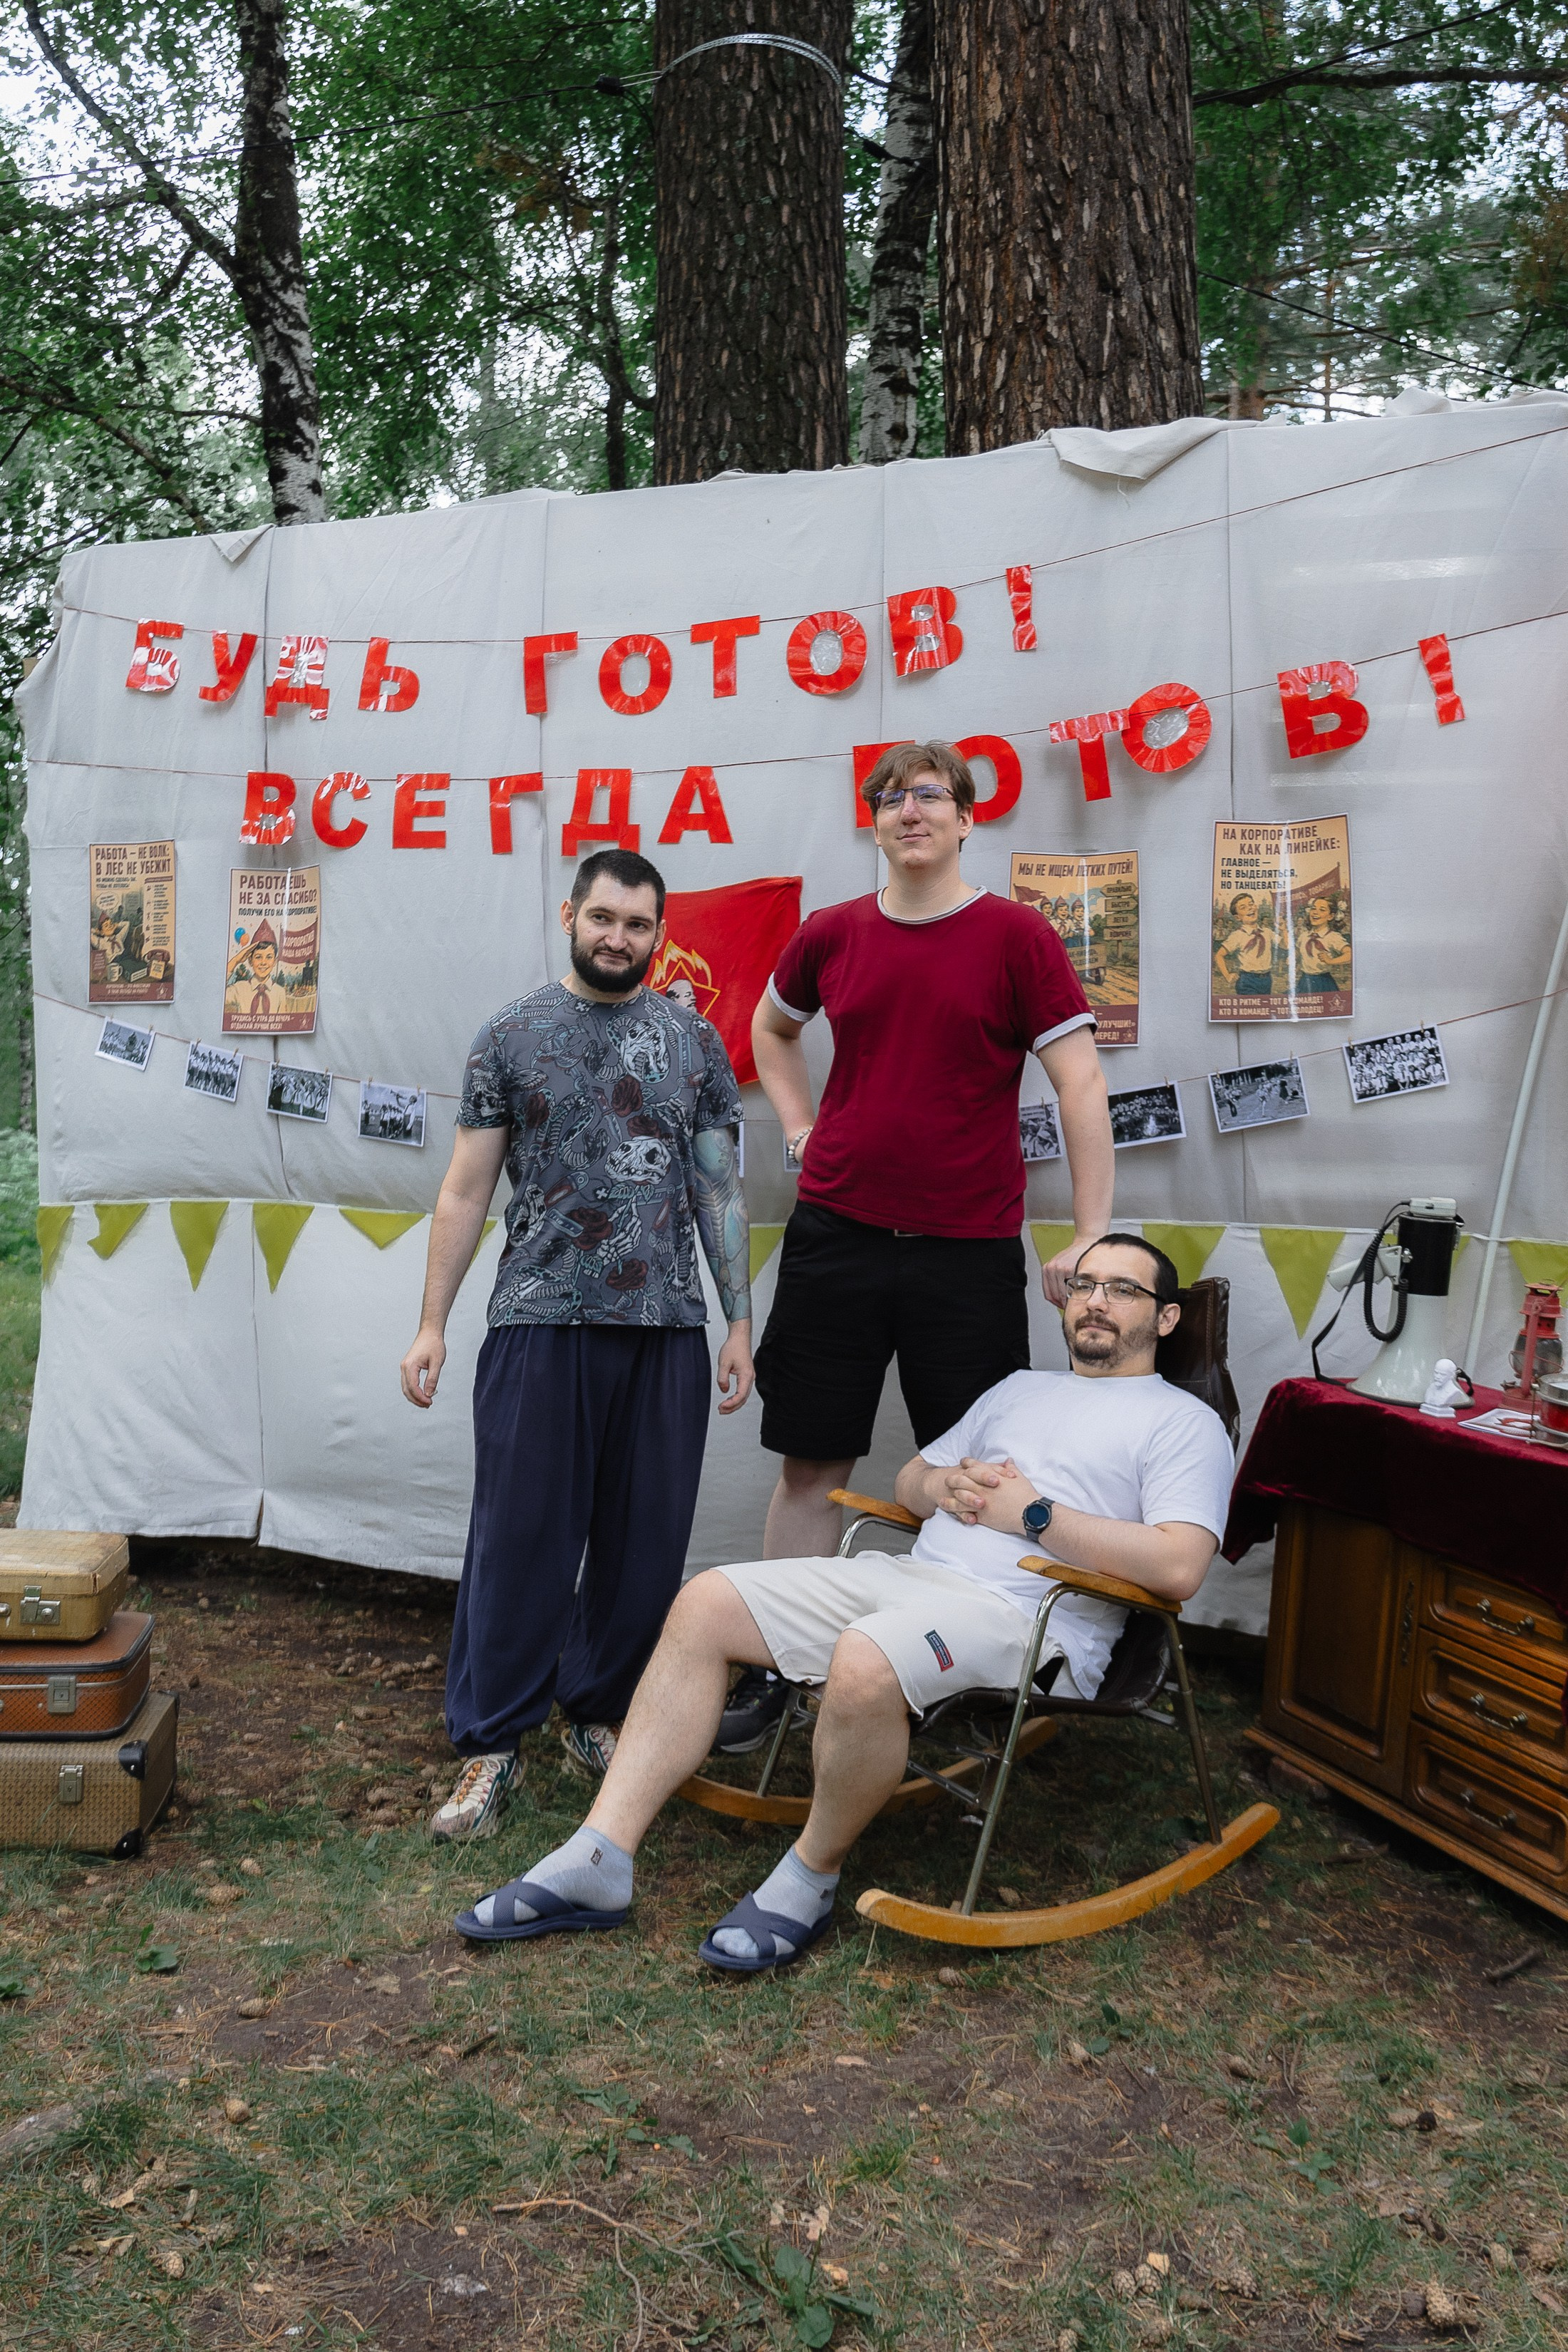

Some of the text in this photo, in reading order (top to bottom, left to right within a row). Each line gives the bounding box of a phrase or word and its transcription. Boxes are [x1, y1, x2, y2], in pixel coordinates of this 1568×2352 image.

[125, 564, 1038, 720] БУДЬ ГОТОВ!
[239, 633, 1465, 857] ВСЕГДА ГОТОВ!
[1222, 825, 1318, 841] НА КОРПОРАТИВЕ
[96, 847, 128, 860] РАБОТА
[138, 847, 147, 860] НЕ
[150, 845, 170, 858] ВОЛК:
[1239, 836, 1341, 855] КАК НА ЛИНЕЙКЕ:
[96, 858, 171, 875] В ЛЕС НЕ УБЕЖИТ
[1018, 863, 1033, 875] МЫ
[1035, 864, 1046, 876] НЕ
[1048, 864, 1074, 878] ИЩЕМ
[1108, 858, 1133, 875] ПУТЕЙ!
[1221, 857, 1260, 867] ГЛАВНОЕ
[240, 874, 306, 889] РАБОТАЕШЬ
[1221, 869, 1298, 880] НЕ ВЫДЕЛЯТЬСЯ,
[1220, 880, 1286, 891] НО ТАНЦЕВАТЬ!
[239, 888, 318, 905] НЕ ЗА СПАСИБО?
[238, 907, 263, 917] ПОЛУЧИ
[264, 908, 275, 917] ЕГО
[276, 908, 284, 917] НА
[1290, 996, 1324, 1004] ОМАНДЕ!
[1291, 1006, 1324, 1015] ОЛОДЕЦ!
[1094, 1031, 1120, 1041] ПЕРЕД!
